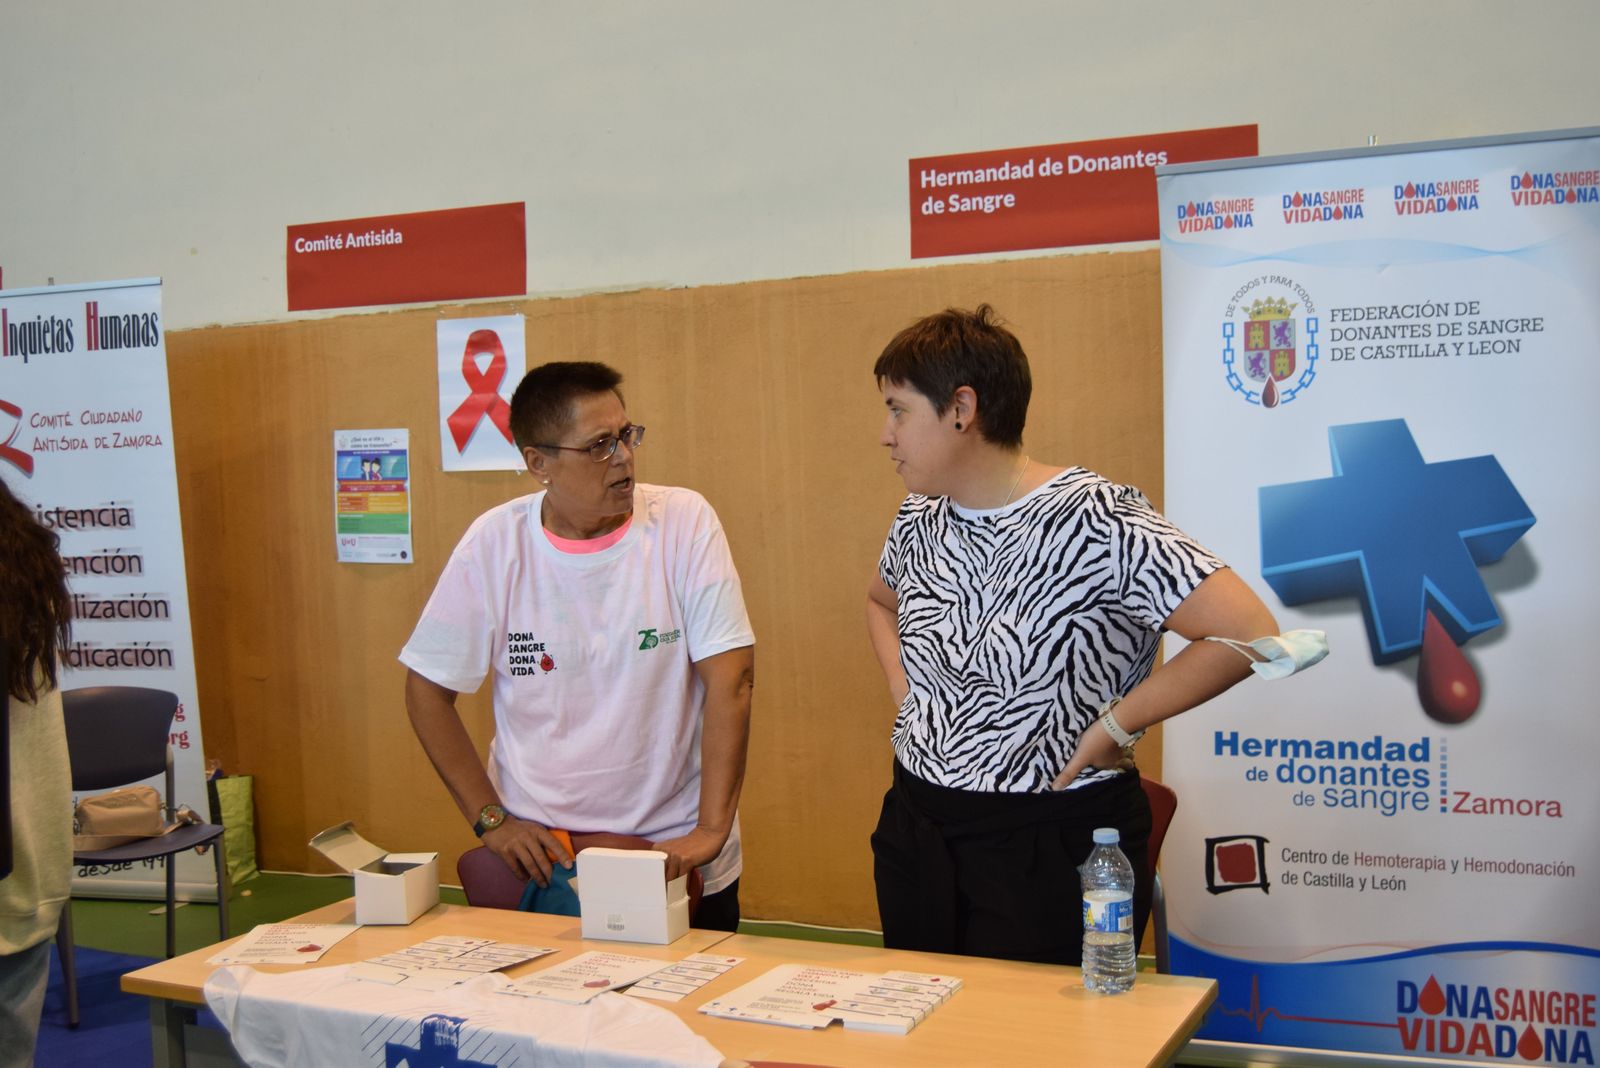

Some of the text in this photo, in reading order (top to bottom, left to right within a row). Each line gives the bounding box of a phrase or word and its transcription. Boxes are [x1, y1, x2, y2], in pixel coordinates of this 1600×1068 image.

[920, 150, 1168, 188] Hermandad de Donantes
[921, 192, 1015, 215] de Sangre
[294, 228, 403, 253] Comité Antisida
[1225, 275, 1315, 318] DE TODOS Y PARA TODOS
[1330, 299, 1481, 322] FEDERACIÓN DE
[1, 301, 160, 363] Inquietas Humanas
[1330, 317, 1544, 342] DONANTES DE SANGRE
[1330, 339, 1522, 361] DE CASTILLA Y LEON
[36, 501, 131, 529] istencia
[63, 548, 142, 575] ención
[74, 592, 169, 619] lización
[508, 632, 534, 642] DONA
[509, 642, 546, 653] SANGRE
[69, 641, 172, 667] dicación
[509, 655, 536, 665] DONA
[510, 666, 535, 676] VIDA
[1214, 731, 1431, 762] Hermandad
[1245, 758, 1431, 788] de donantes
[1293, 788, 1430, 817] de sangre
[1452, 791, 1563, 818] Zamora
[1281, 847, 1576, 878] Centro de Hemoterapia y Hemodonación
[1281, 870, 1407, 892] de Castilla y León
